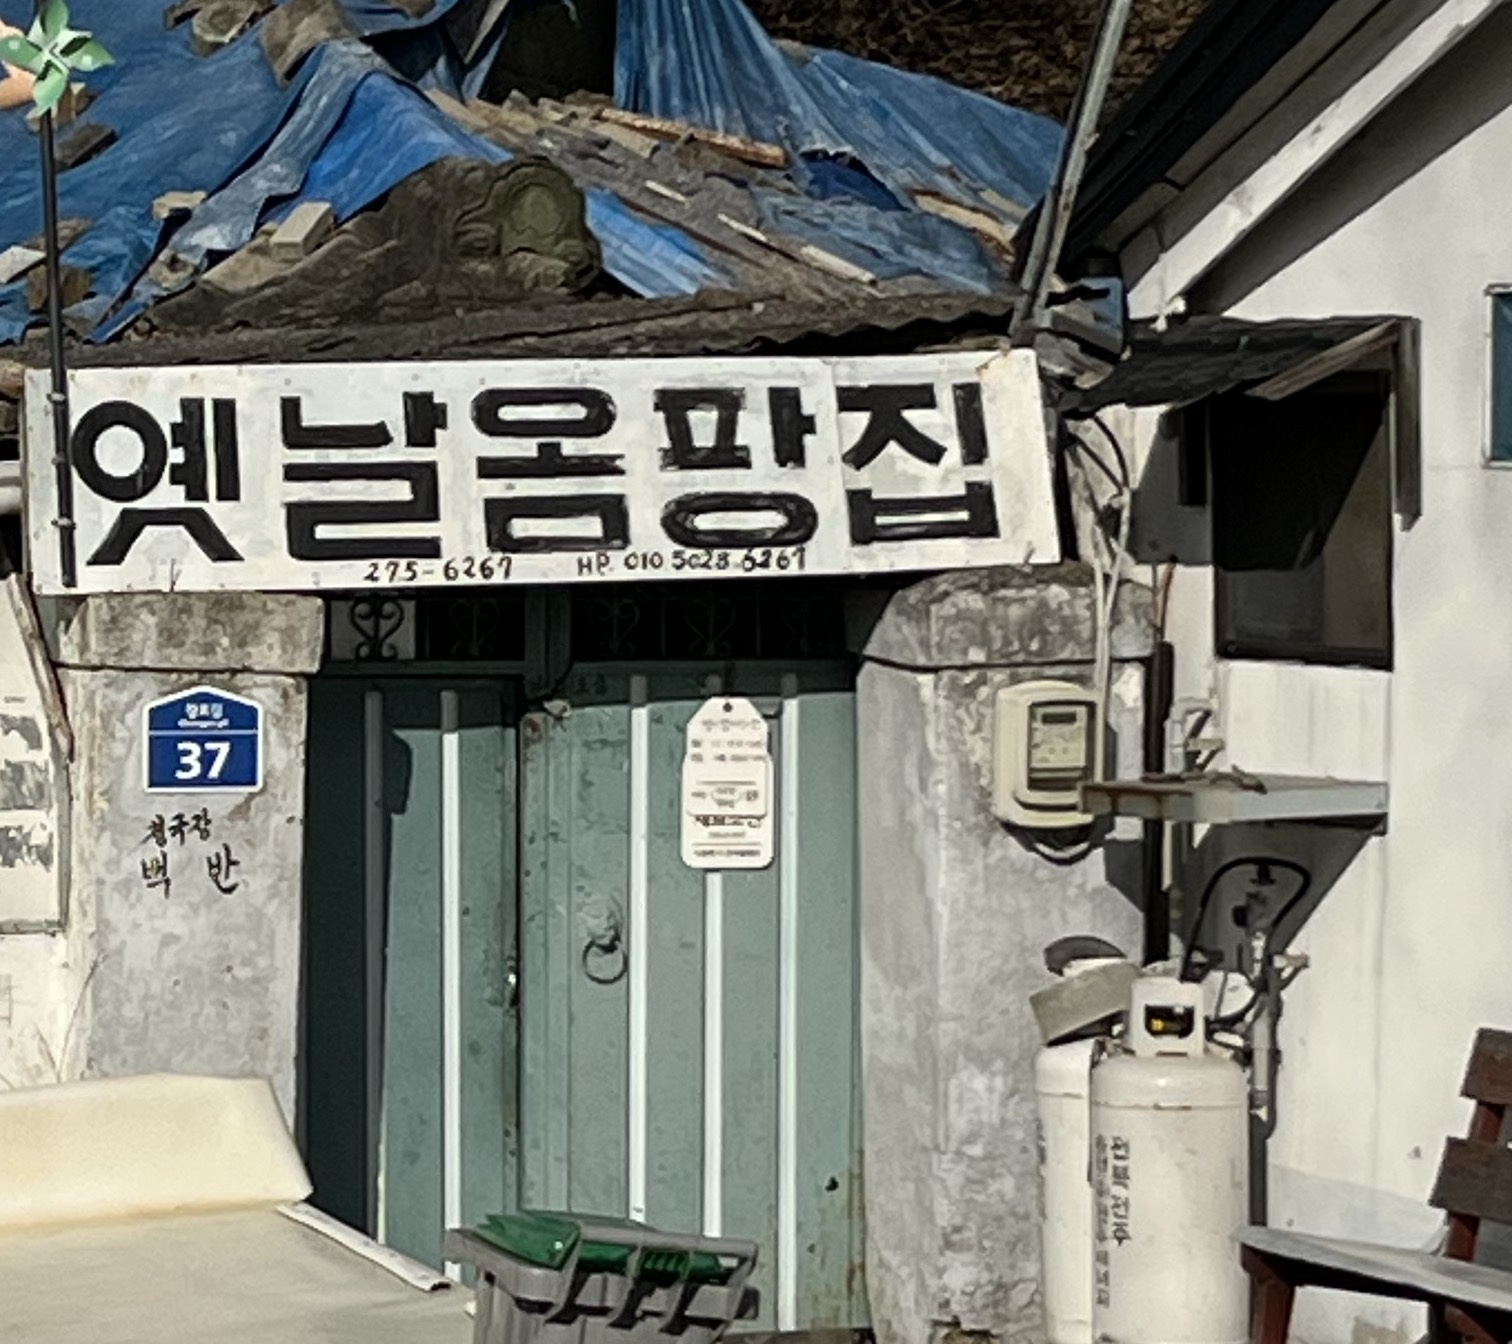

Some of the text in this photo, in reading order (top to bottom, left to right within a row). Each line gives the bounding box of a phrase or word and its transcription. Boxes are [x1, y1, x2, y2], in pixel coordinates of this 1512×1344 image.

[363, 556, 513, 583] 275-6267
[174, 741, 231, 780] 37
[140, 807, 212, 848] 청국장
